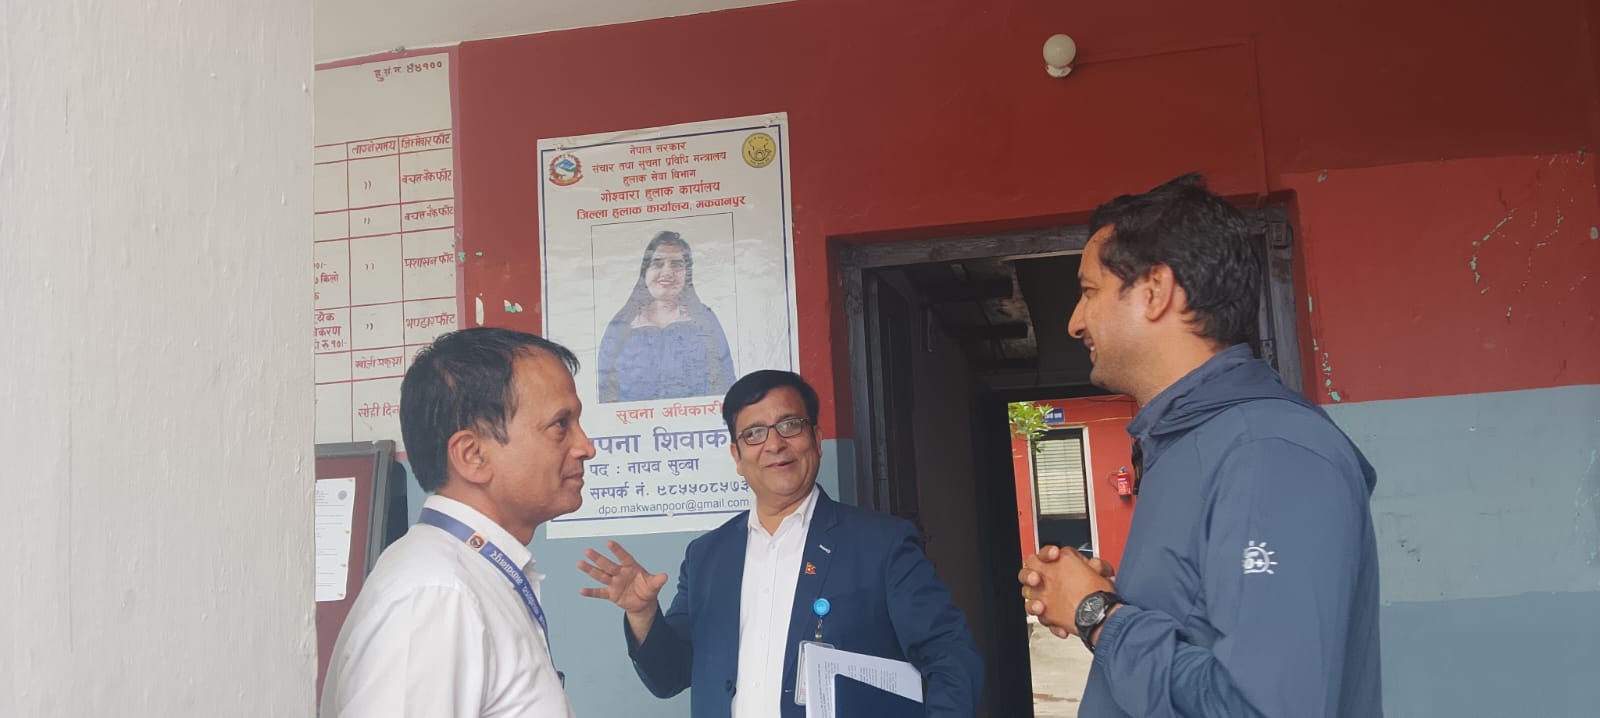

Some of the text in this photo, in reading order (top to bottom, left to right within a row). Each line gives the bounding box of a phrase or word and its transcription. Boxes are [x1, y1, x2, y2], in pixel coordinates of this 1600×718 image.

[630, 142, 687, 155] नेपाल सरकार
[592, 151, 727, 173] संचार तथा सूचना प्रविधि मन्त्रालय
[623, 169, 696, 186] हुलाक सेवा विभाग
[600, 180, 721, 202] गोश्वारा हुलाक कार्यालय
[577, 209, 608, 221] जिल्ला
[612, 206, 642, 219] हुलाक
[696, 195, 747, 210] मकवानपुर
[616, 400, 722, 424] सूचना अधिकारी
[589, 434, 641, 454] पना
[589, 464, 609, 477] पद
[627, 460, 661, 475] नायब
[589, 482, 630, 500] सम्पर्क
[598, 498, 749, 514] dpo.makwanpoor@gmail.com
